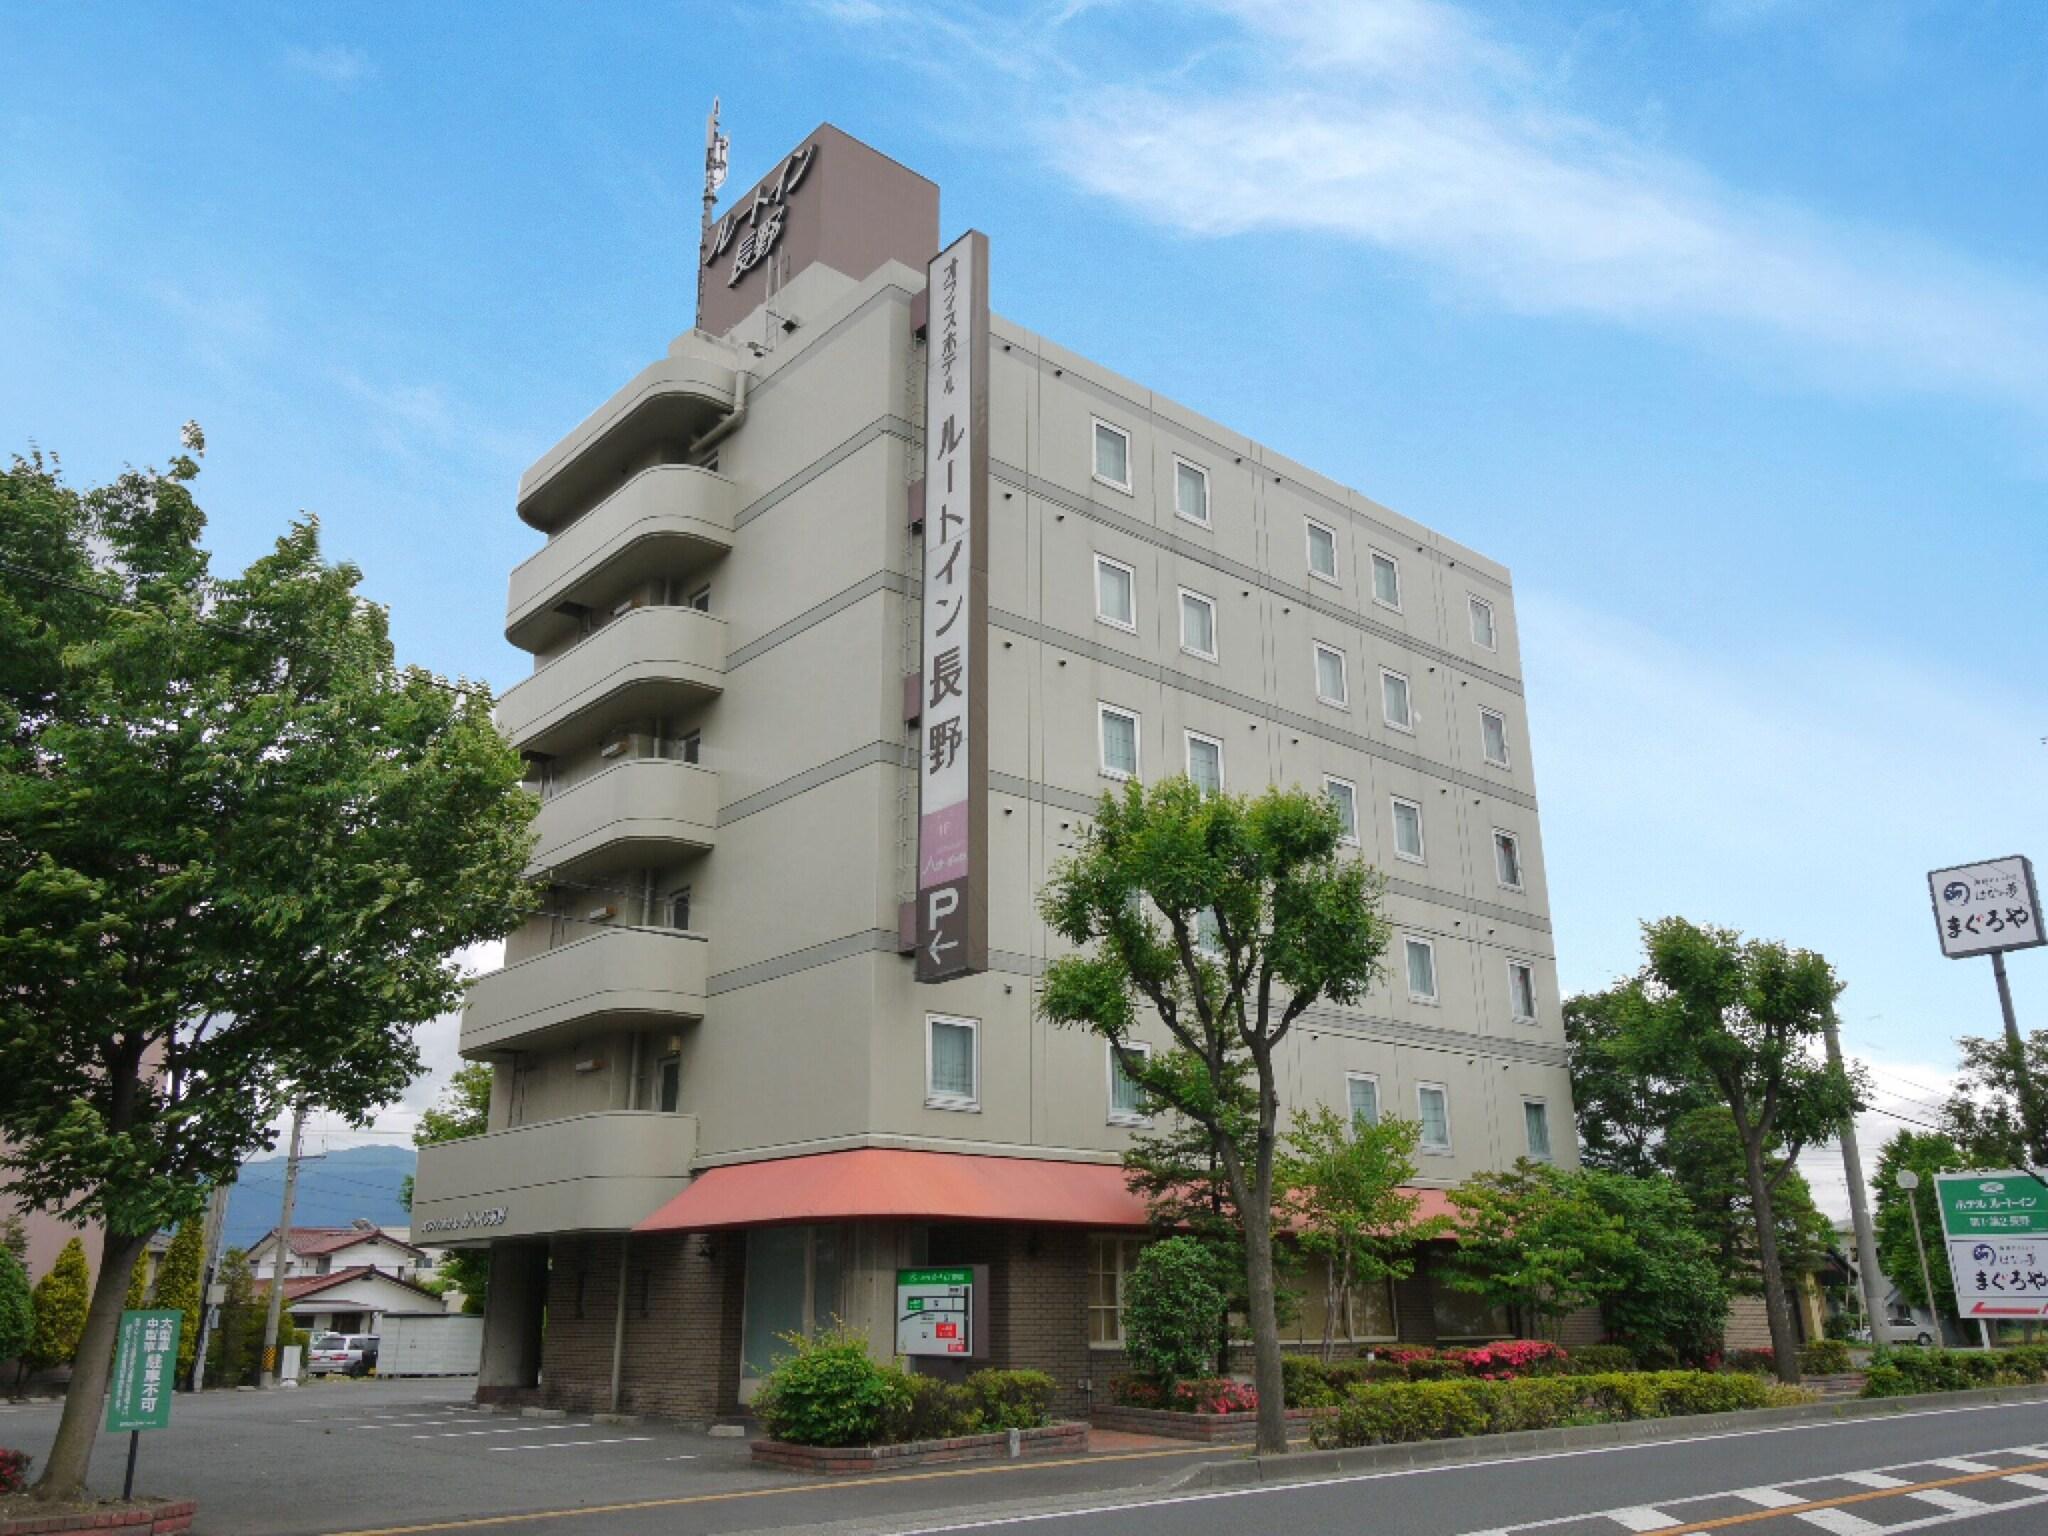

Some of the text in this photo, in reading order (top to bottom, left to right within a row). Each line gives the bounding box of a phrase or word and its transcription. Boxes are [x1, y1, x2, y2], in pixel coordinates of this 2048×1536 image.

[702, 144, 818, 267] ルートイン
[728, 204, 788, 288] 長野
[929, 413, 965, 776] ルートイン長野
[928, 887, 959, 931] P
[1947, 905, 2029, 939] まぐろや
[1955, 1199, 1987, 1211] ホテル
[1975, 1269, 2048, 1291] まぐろや
